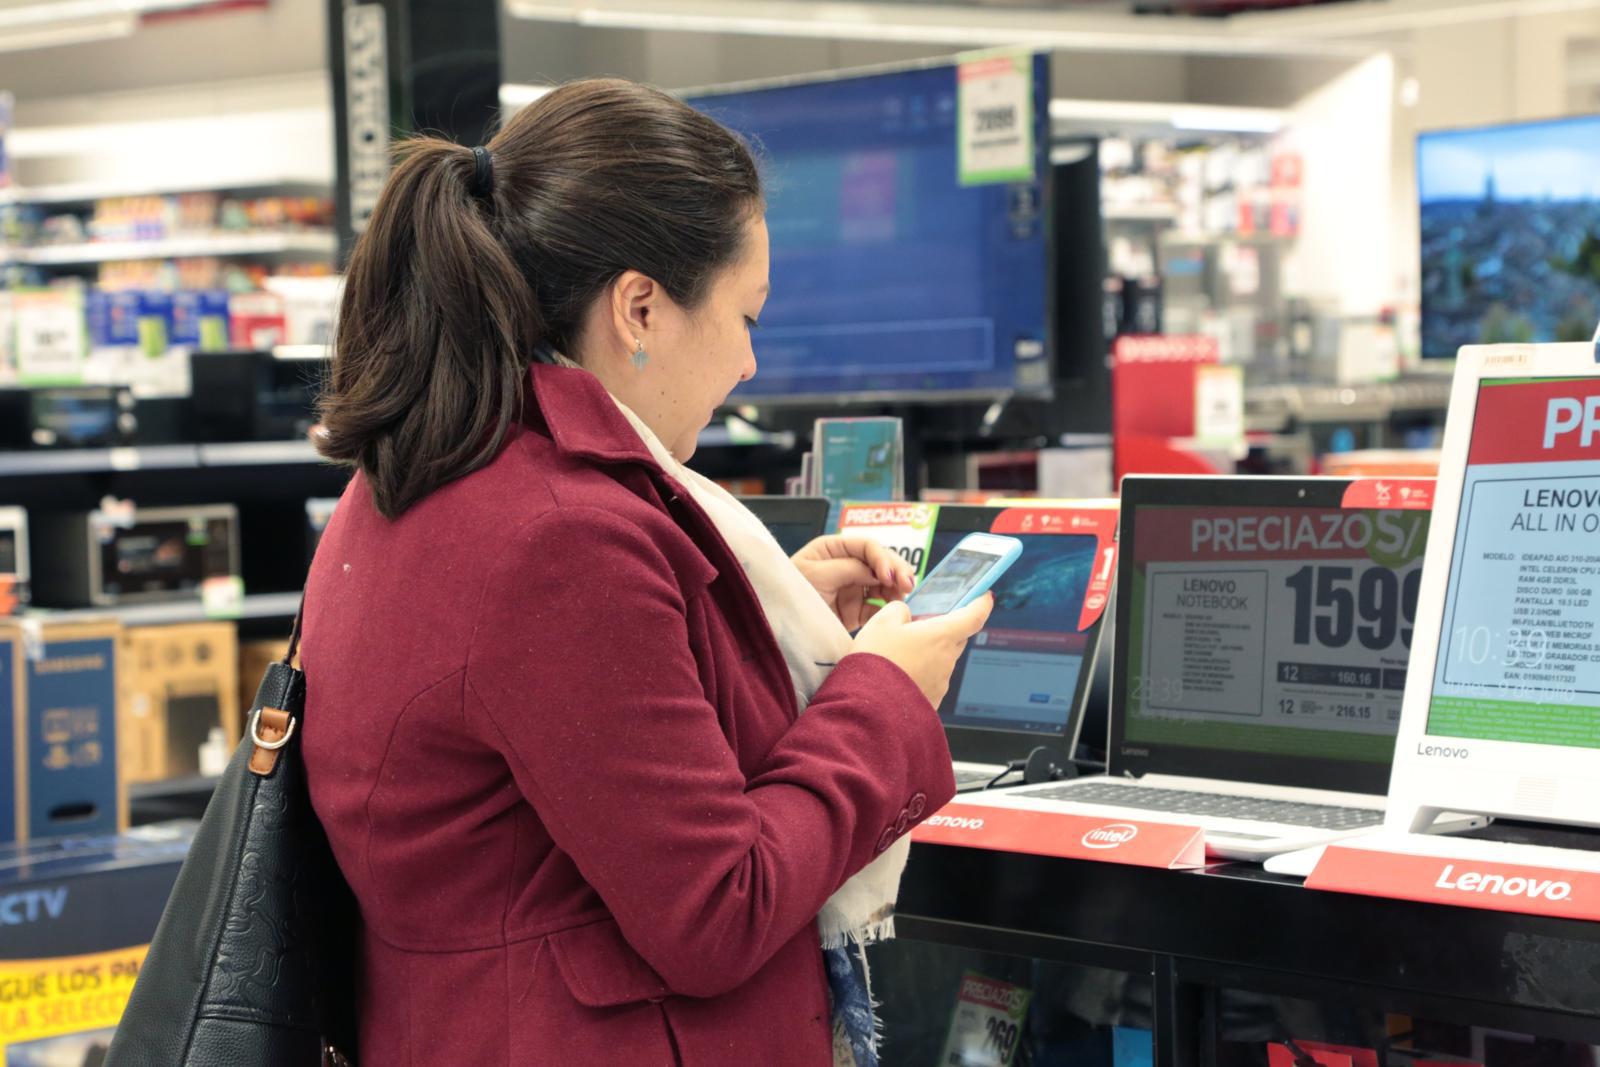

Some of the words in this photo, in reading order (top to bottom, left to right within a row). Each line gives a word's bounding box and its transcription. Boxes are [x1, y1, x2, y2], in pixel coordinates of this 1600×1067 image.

[1523, 488, 1600, 508] LENOV
[1511, 513, 1549, 531] ALL
[1555, 513, 1576, 532] IN
[1583, 513, 1600, 533] O
[1520, 565, 1540, 574] INTEL
[1542, 565, 1578, 575] CELERON
[1580, 567, 1596, 575] CPU
[1183, 578, 1236, 594] LENOVO
[1536, 576, 1552, 584] 4GB
[1516, 586, 1539, 594] DISCO
[1541, 587, 1563, 595] DURO
[1176, 595, 1248, 611] NOTEBOOK
[1515, 597, 1554, 606] PANTALLA
[1573, 599, 1589, 608] LED
[1513, 607, 1529, 616] USB
[1552, 642, 1592, 651] MEMORIAS
[1282, 665, 1299, 681] 12
[1554, 663, 1576, 672] HOME
[1278, 699, 1295, 714] 12
[1336, 704, 1372, 719] 216.15
[1417, 743, 1469, 760] Lenovo
[1435, 864, 1571, 901] Lenovo
[0, 885, 68, 926] CTV
[57, 962, 102, 993] LOS
